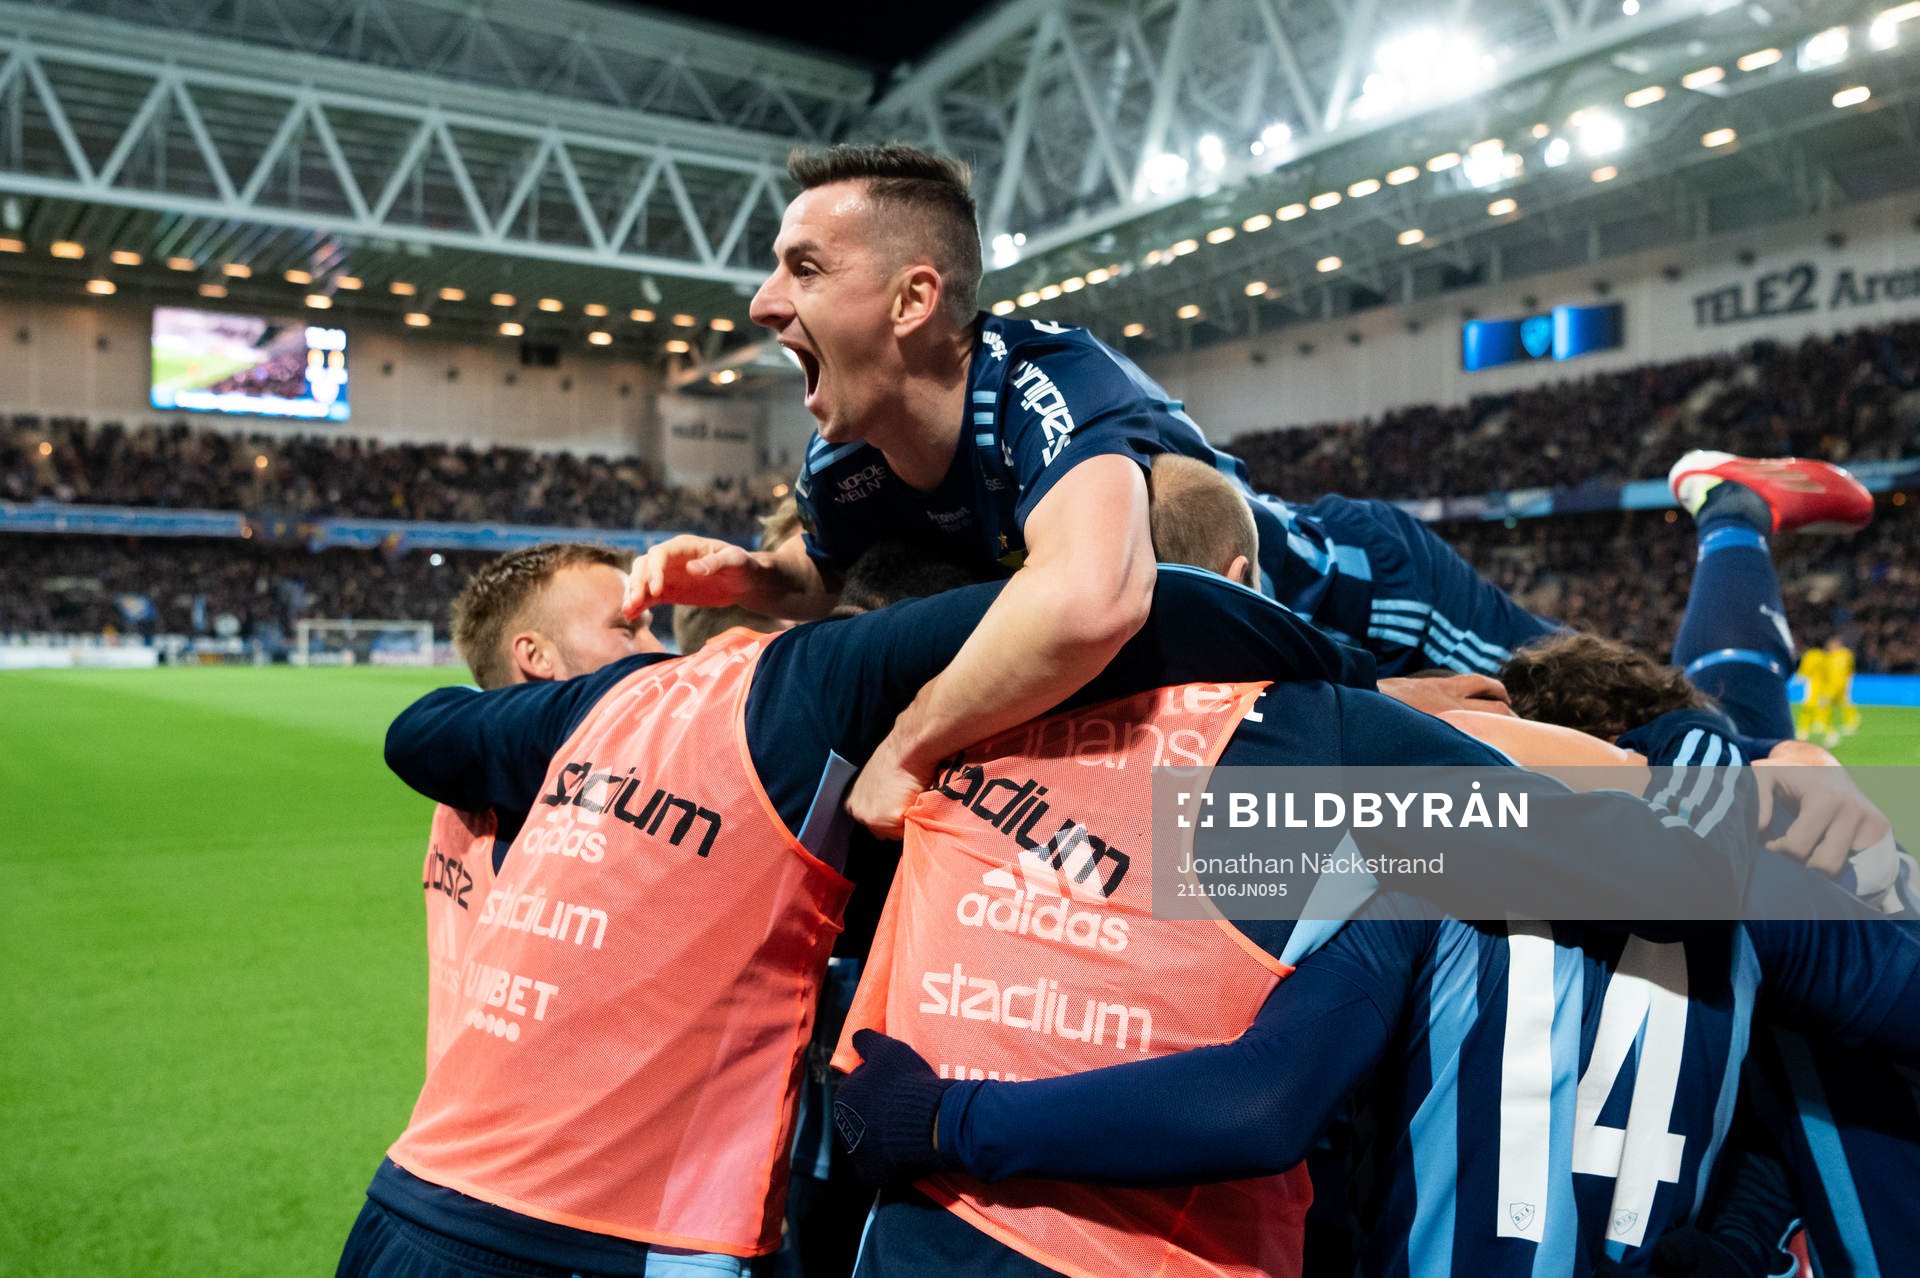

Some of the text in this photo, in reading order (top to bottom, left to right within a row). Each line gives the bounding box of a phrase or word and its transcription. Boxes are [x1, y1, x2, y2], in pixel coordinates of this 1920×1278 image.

[1692, 262, 1819, 328] TELE2
[935, 751, 1130, 898] tadium
[956, 889, 1130, 952] adidas
[919, 963, 1153, 1053] stadium
[1496, 911, 1689, 1247] 14
